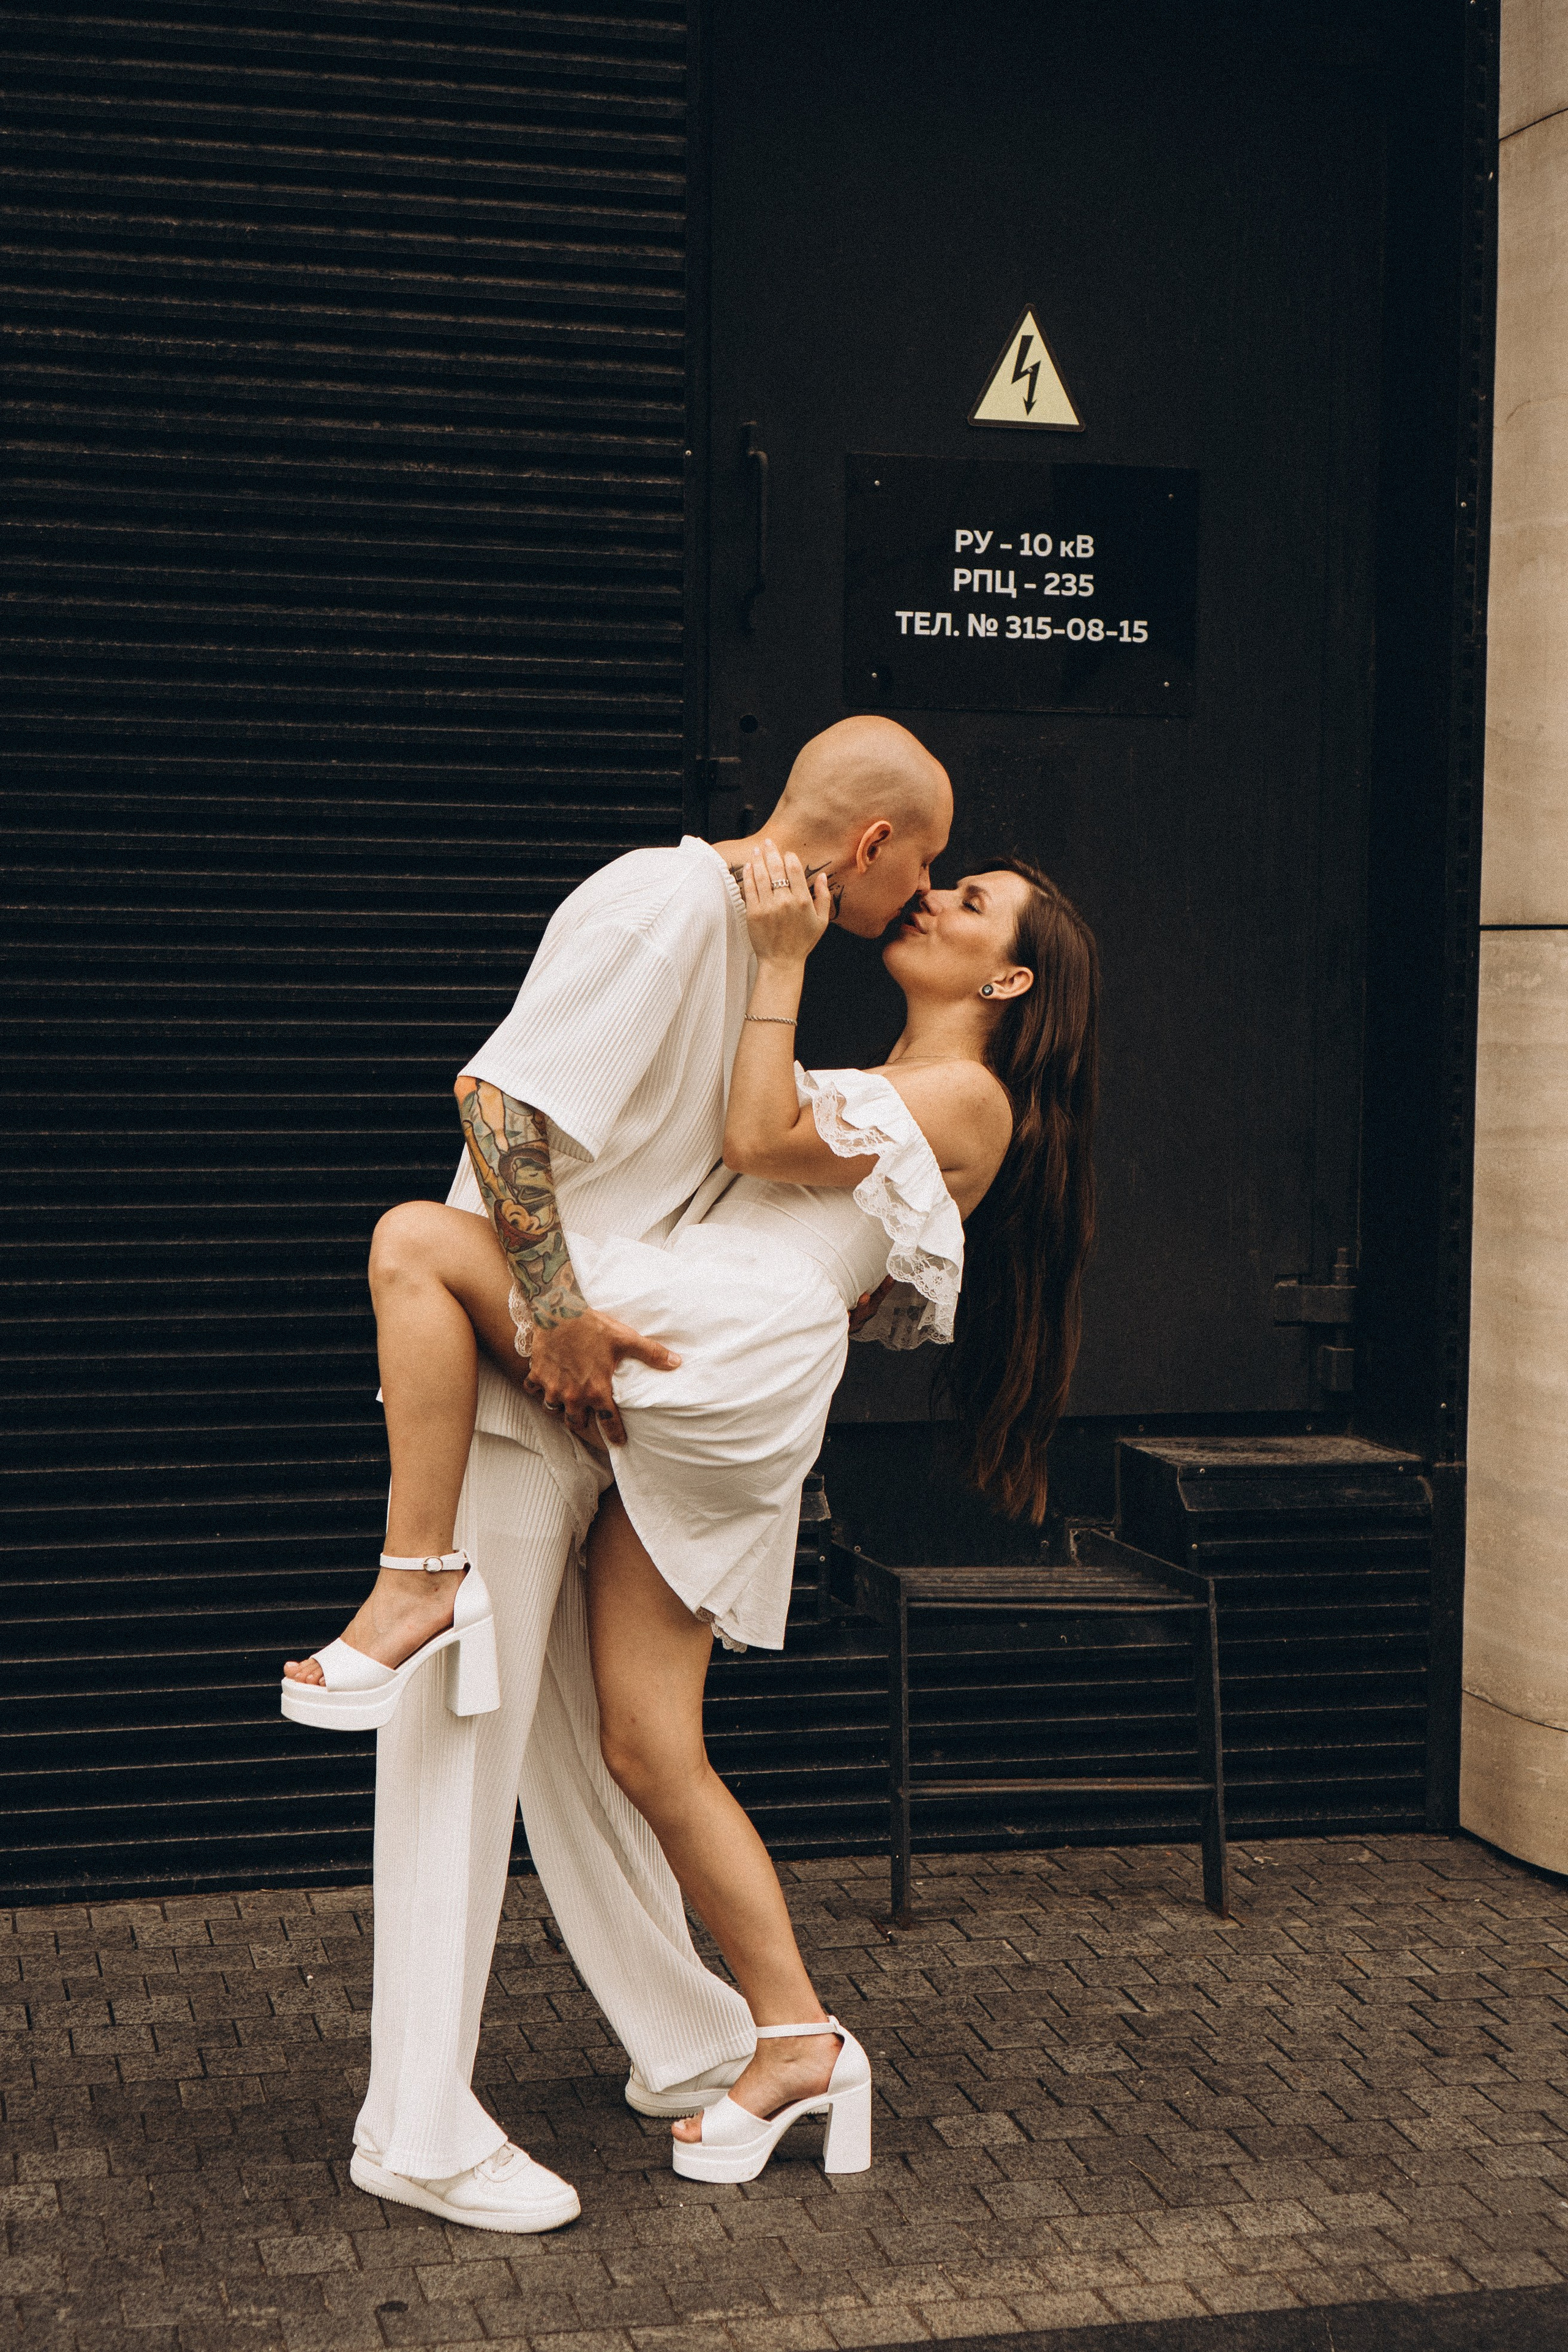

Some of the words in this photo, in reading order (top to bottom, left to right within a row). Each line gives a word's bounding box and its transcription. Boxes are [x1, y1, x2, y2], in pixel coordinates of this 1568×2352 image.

[955, 529, 993, 554] РУ
[1020, 533, 1053, 557] 10
[1060, 535, 1095, 558] кВ
[954, 568, 1017, 598] РПЦ
[1044, 572, 1095, 597] 235
[895, 611, 960, 637] ТЕЛ.
[968, 613, 998, 638] №
